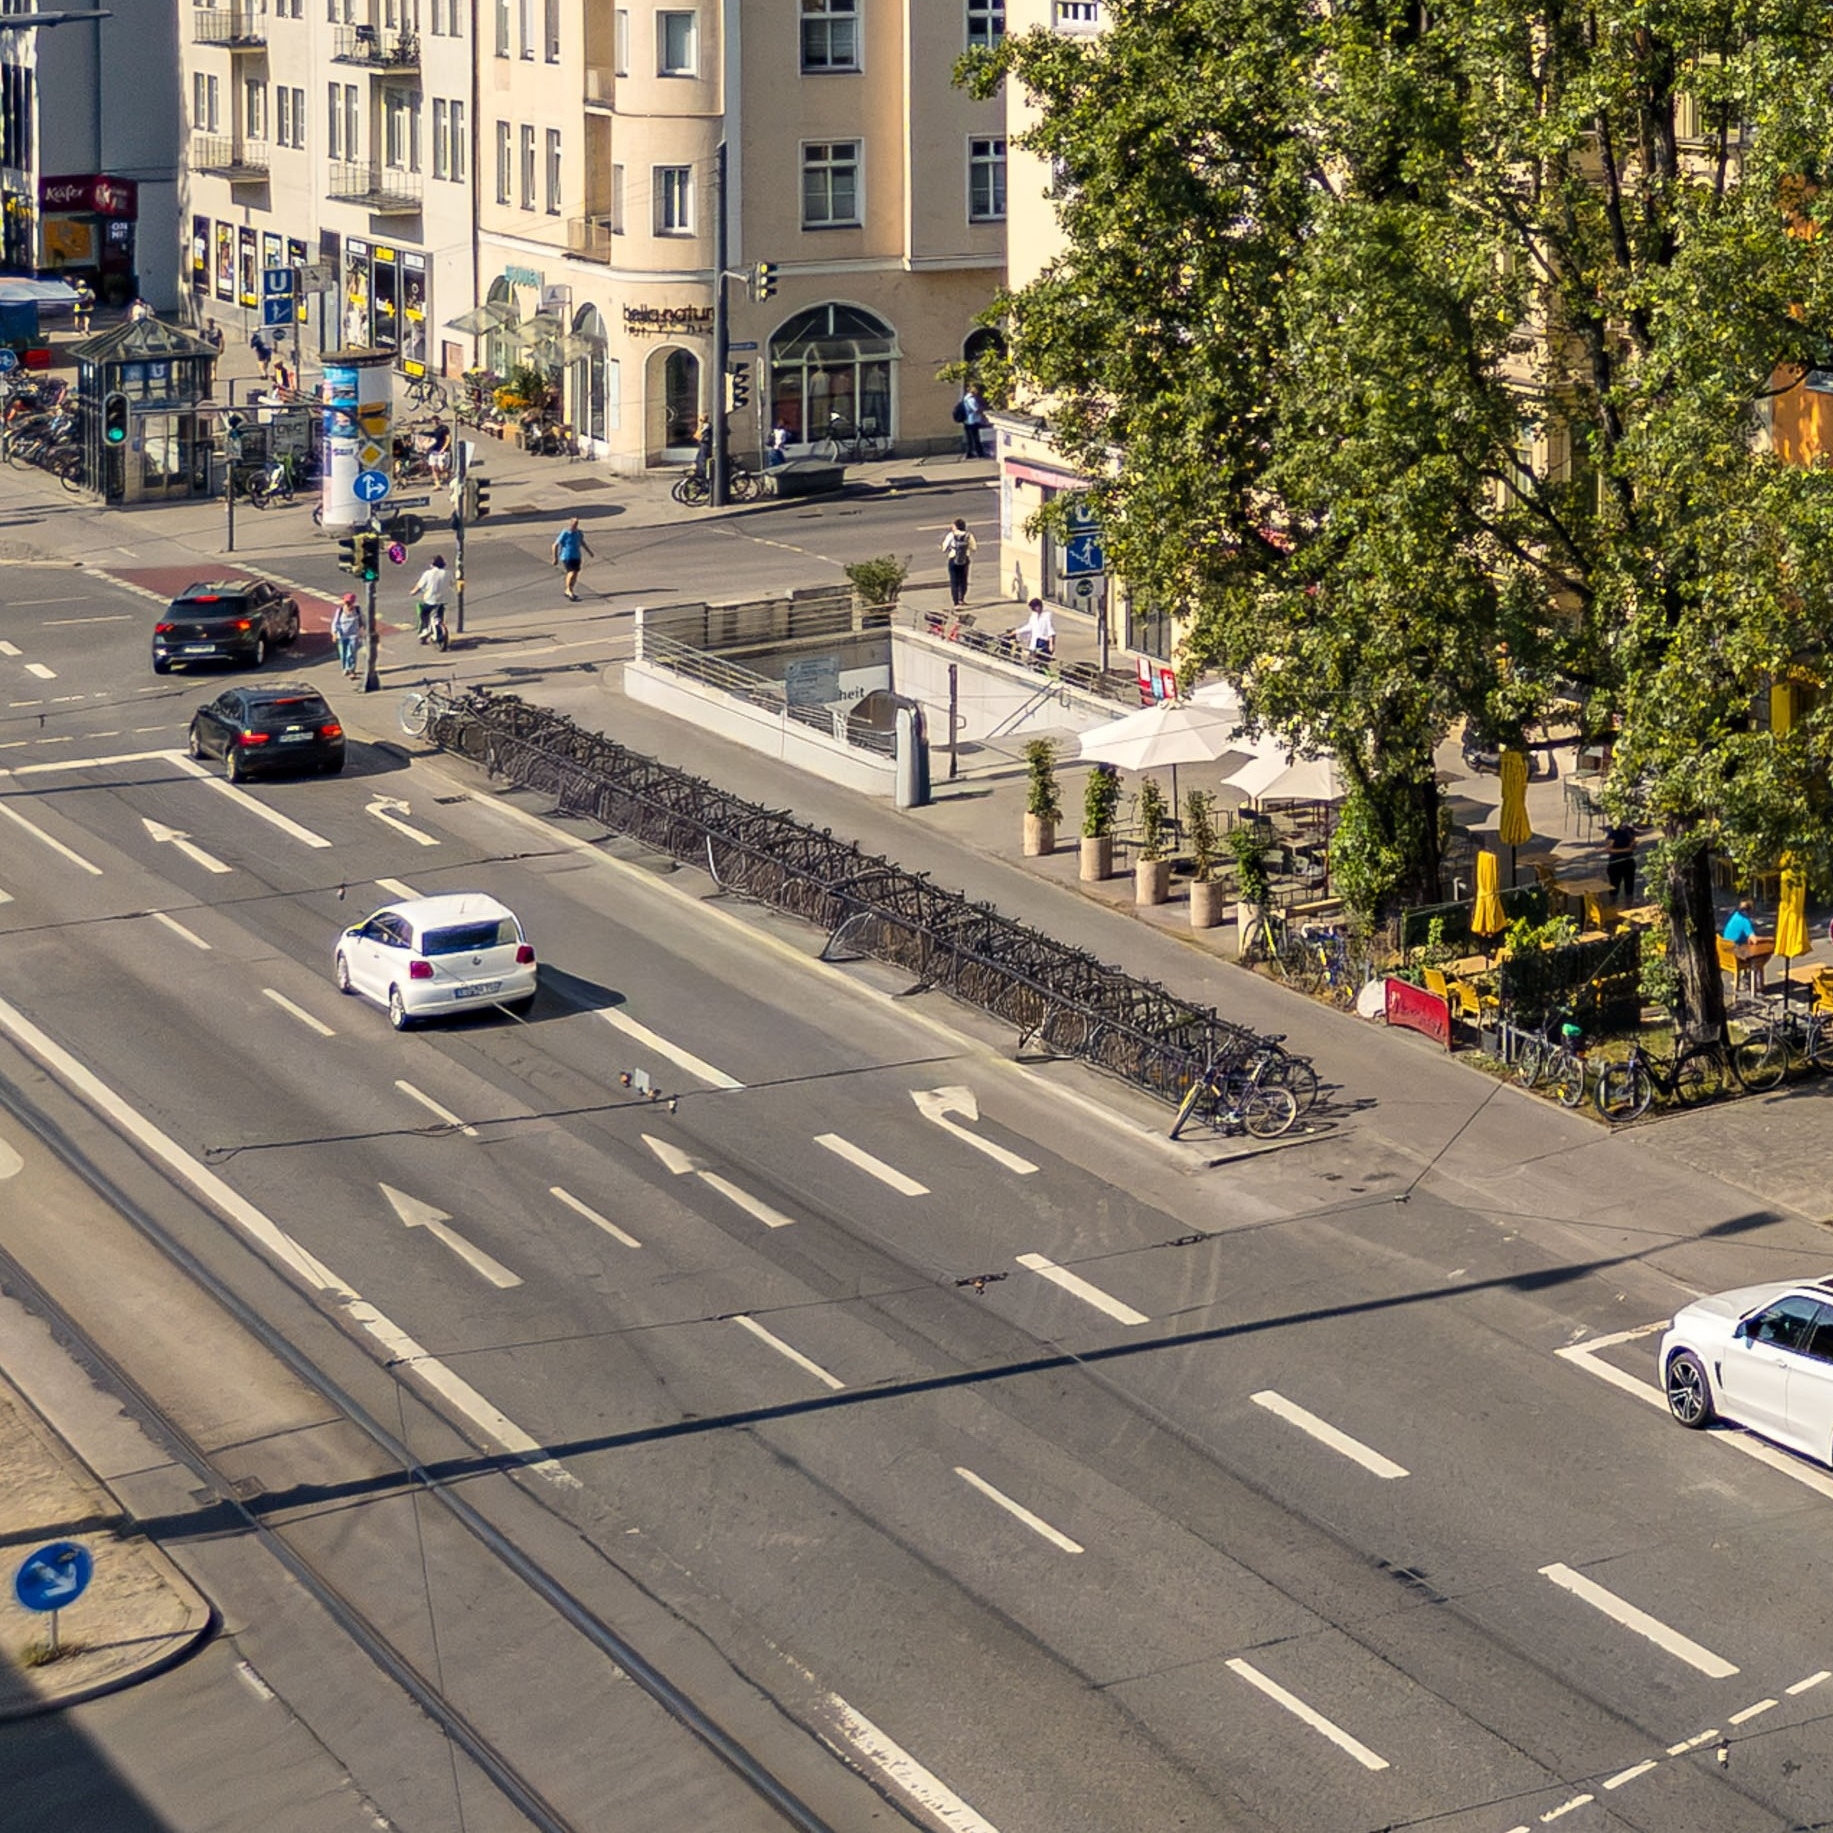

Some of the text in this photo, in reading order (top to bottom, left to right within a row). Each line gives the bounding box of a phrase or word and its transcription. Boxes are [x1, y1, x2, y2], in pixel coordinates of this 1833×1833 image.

[268, 272, 288, 292] U
[623, 303, 715, 323] bella natur
